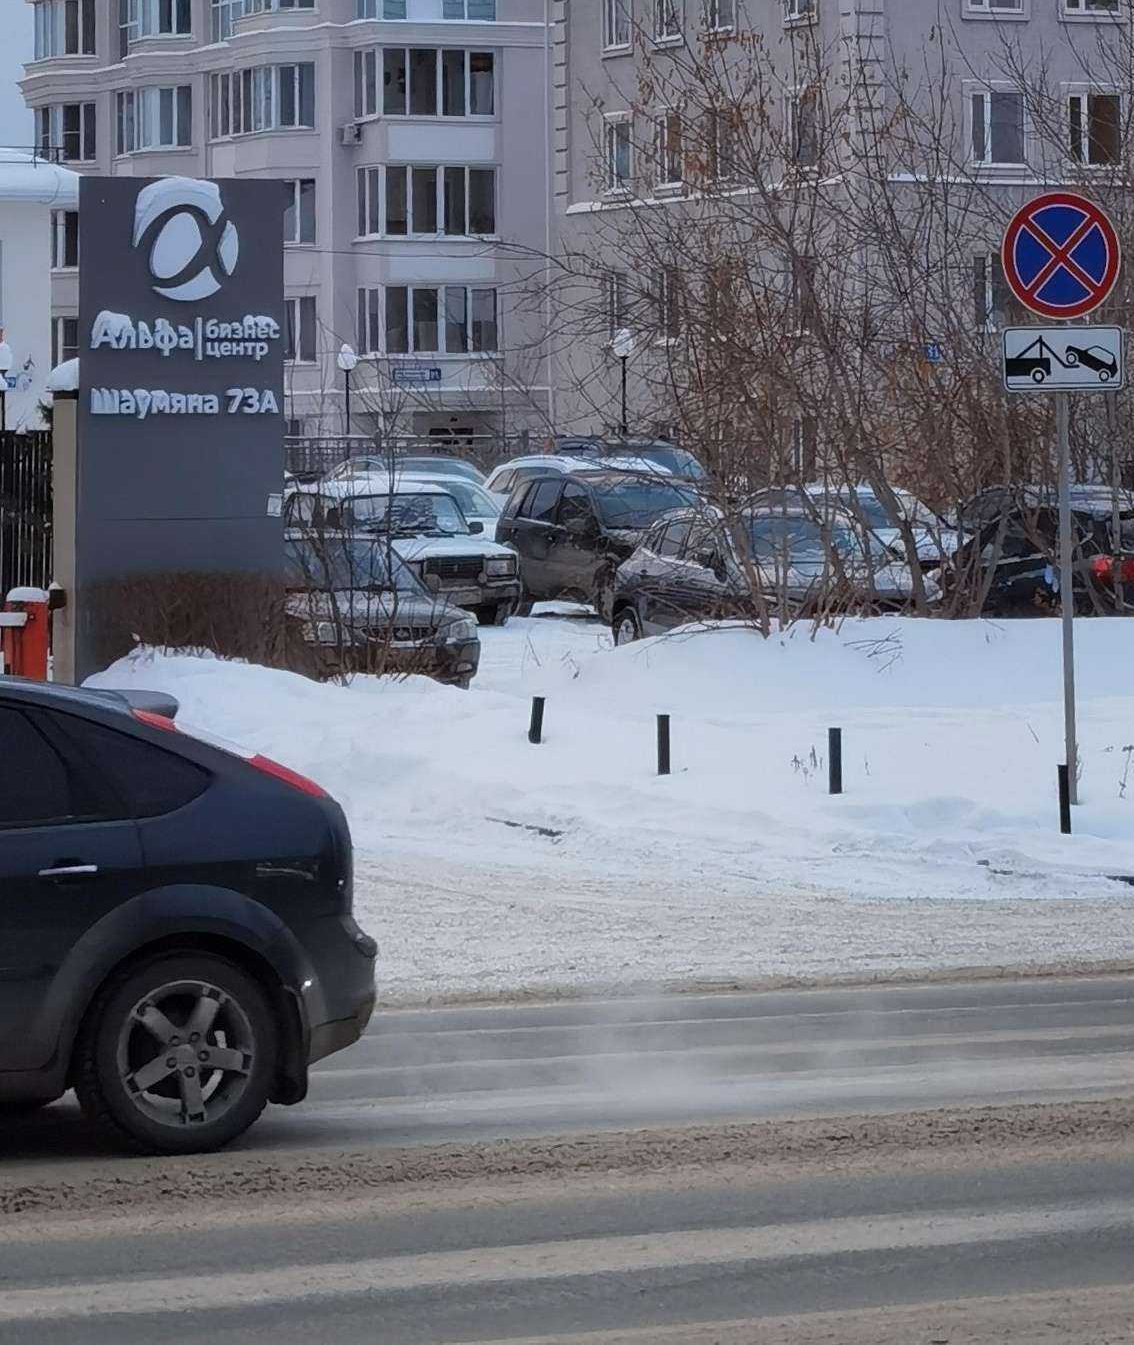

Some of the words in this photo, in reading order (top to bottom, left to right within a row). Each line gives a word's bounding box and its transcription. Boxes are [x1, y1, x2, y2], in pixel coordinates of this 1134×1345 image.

[90, 310, 194, 356] Альфа
[205, 315, 280, 339] бизнес
[206, 341, 269, 361] центр
[90, 387, 219, 419] Шаумяна
[225, 388, 279, 414] 73А
